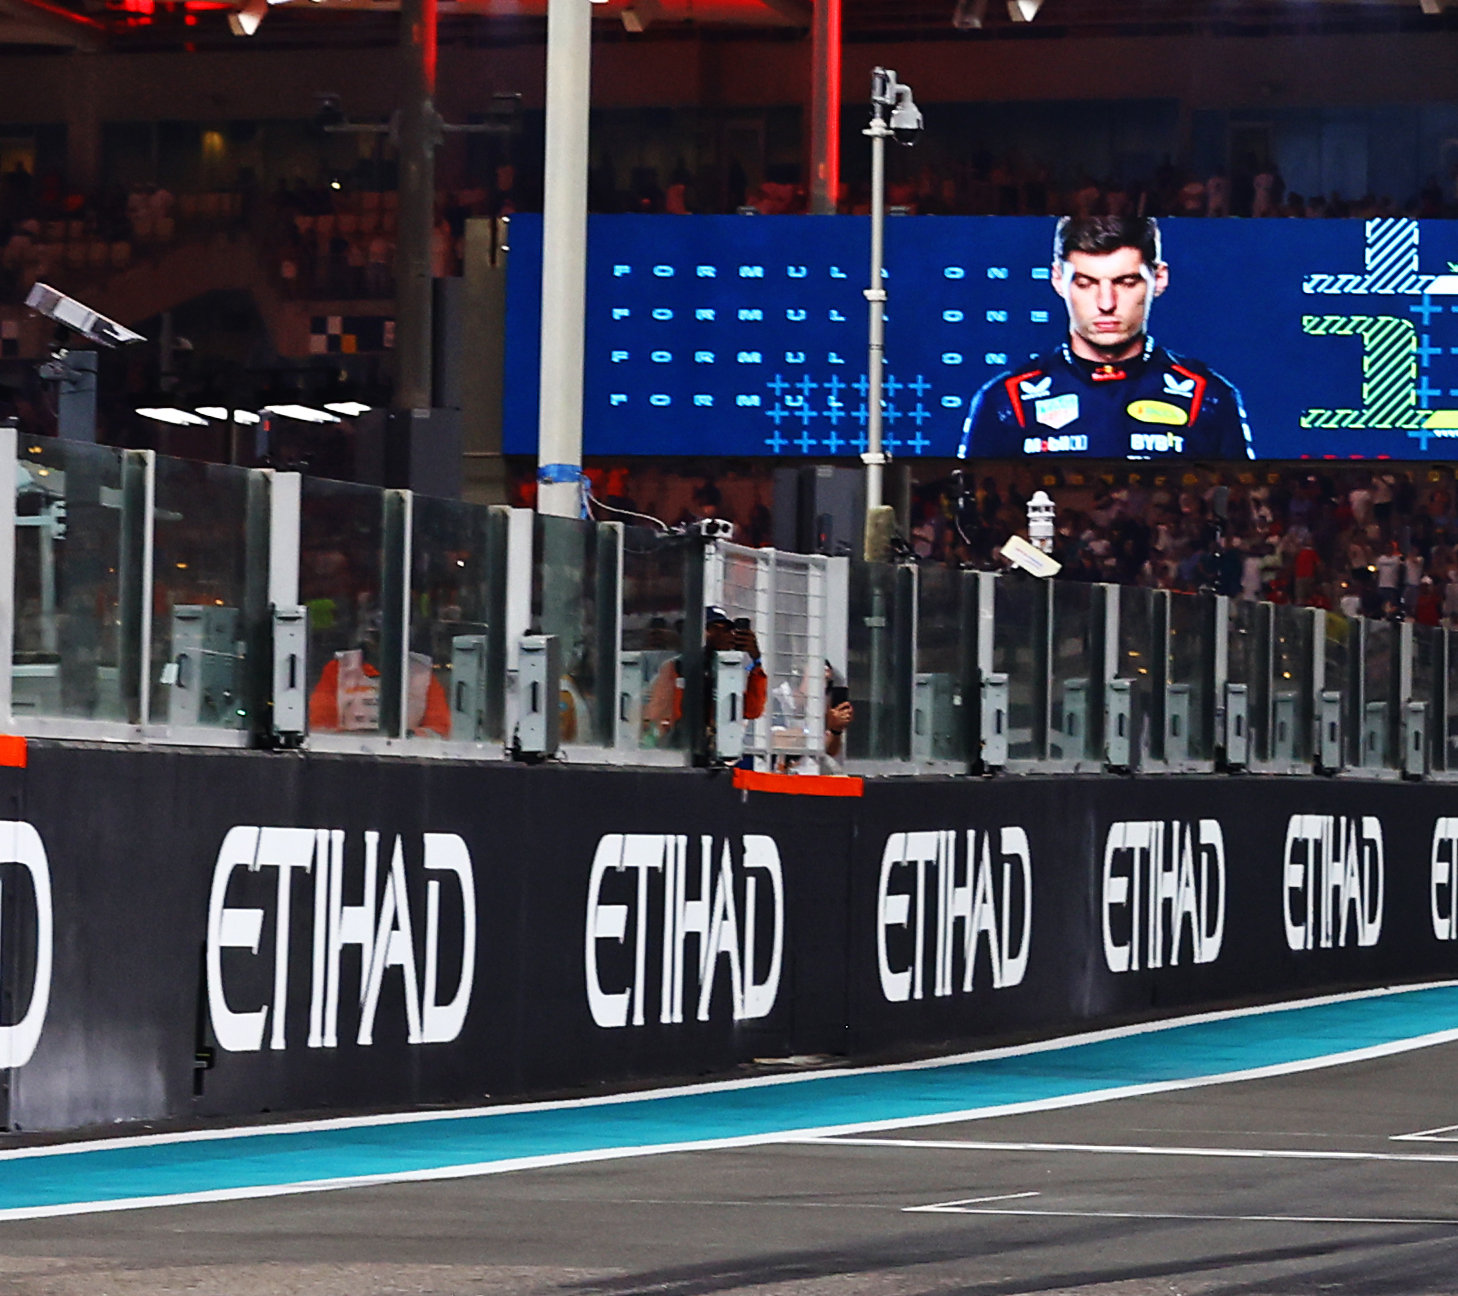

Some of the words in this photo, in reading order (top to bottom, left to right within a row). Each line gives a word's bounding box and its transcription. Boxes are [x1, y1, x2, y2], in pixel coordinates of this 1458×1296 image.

[207, 825, 476, 1051] ETIHAD
[586, 833, 783, 1027] ETIHAD
[877, 826, 1031, 1002] ETIHAD
[1102, 819, 1225, 972] ETIHAD
[1284, 814, 1385, 951] ETIHAD
